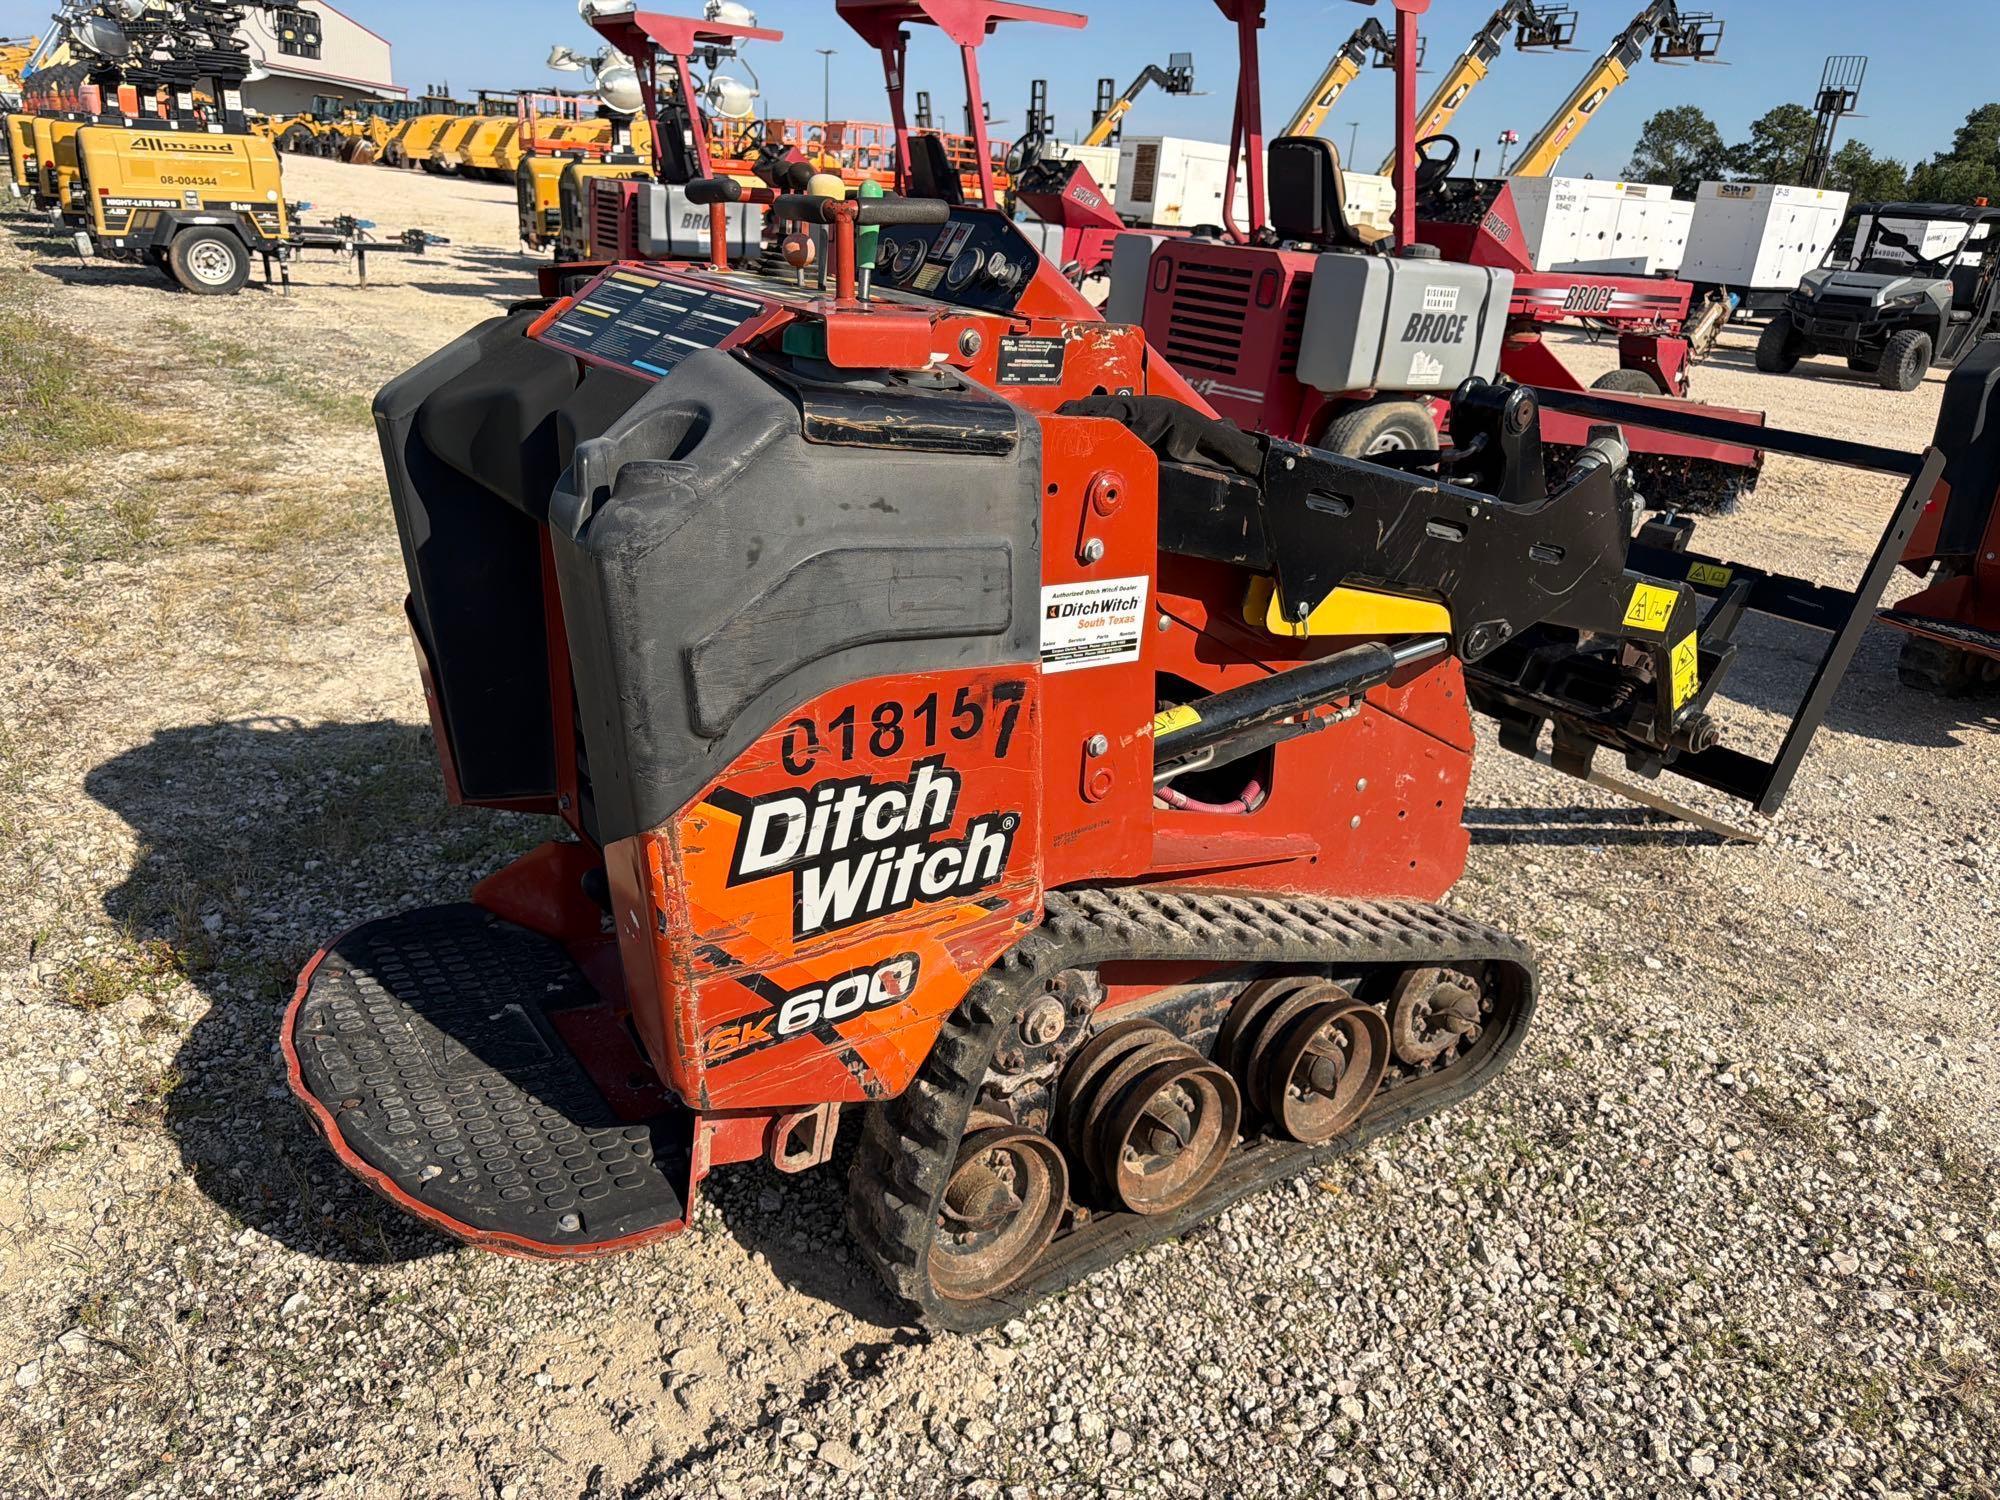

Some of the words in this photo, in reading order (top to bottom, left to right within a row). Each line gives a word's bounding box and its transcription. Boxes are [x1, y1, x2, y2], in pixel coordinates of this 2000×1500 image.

[130, 137, 234, 154] Allmand
[160, 175, 218, 186] 08-004344
[1483, 211, 1511, 243] BW260
[1562, 286, 1616, 312] BROCE
[1400, 312, 1468, 344] BROCE
[1052, 590, 1084, 599] Authorized
[1078, 618, 1106, 630] South
[1108, 615, 1136, 625] Texas
[780, 681, 1027, 777] 018157
[738, 764, 954, 876] Ditch
